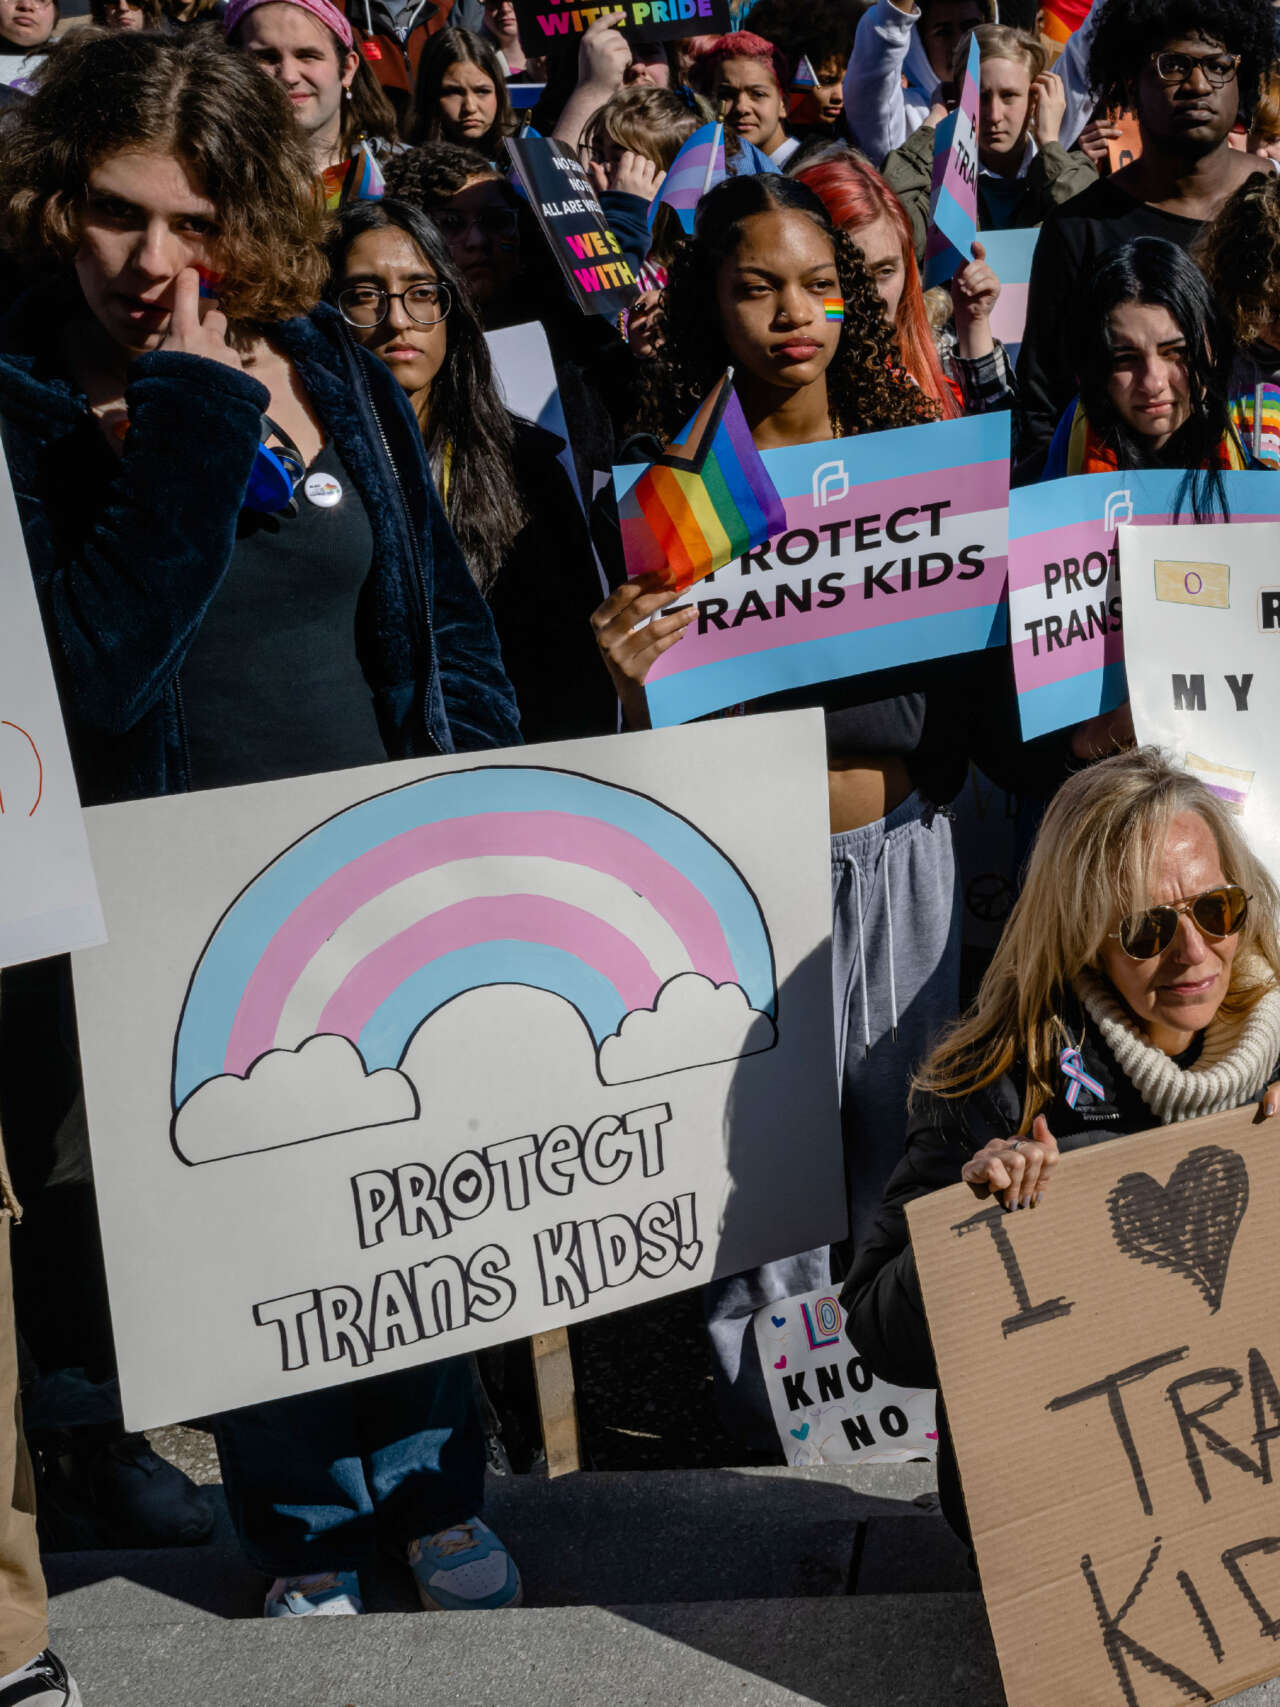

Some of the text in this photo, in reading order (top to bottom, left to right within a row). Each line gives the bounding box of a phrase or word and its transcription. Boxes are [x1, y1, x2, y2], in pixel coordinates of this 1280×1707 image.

[632, 0, 713, 25] PRIDE
[552, 157, 570, 170] NO
[568, 177, 585, 191] NO
[541, 203, 564, 217] ALL
[564, 200, 586, 214] ARE
[565, 231, 609, 260] WE
[573, 260, 637, 293] WITH
[704, 500, 951, 583] ROTECT
[864, 544, 985, 600] KIDS
[1024, 597, 1122, 657] TRANS
[1172, 672, 1254, 712] MY
[534, 1192, 704, 1309] KIDS!
[950, 1204, 1077, 1340] I
[841, 1405, 909, 1451] NO
